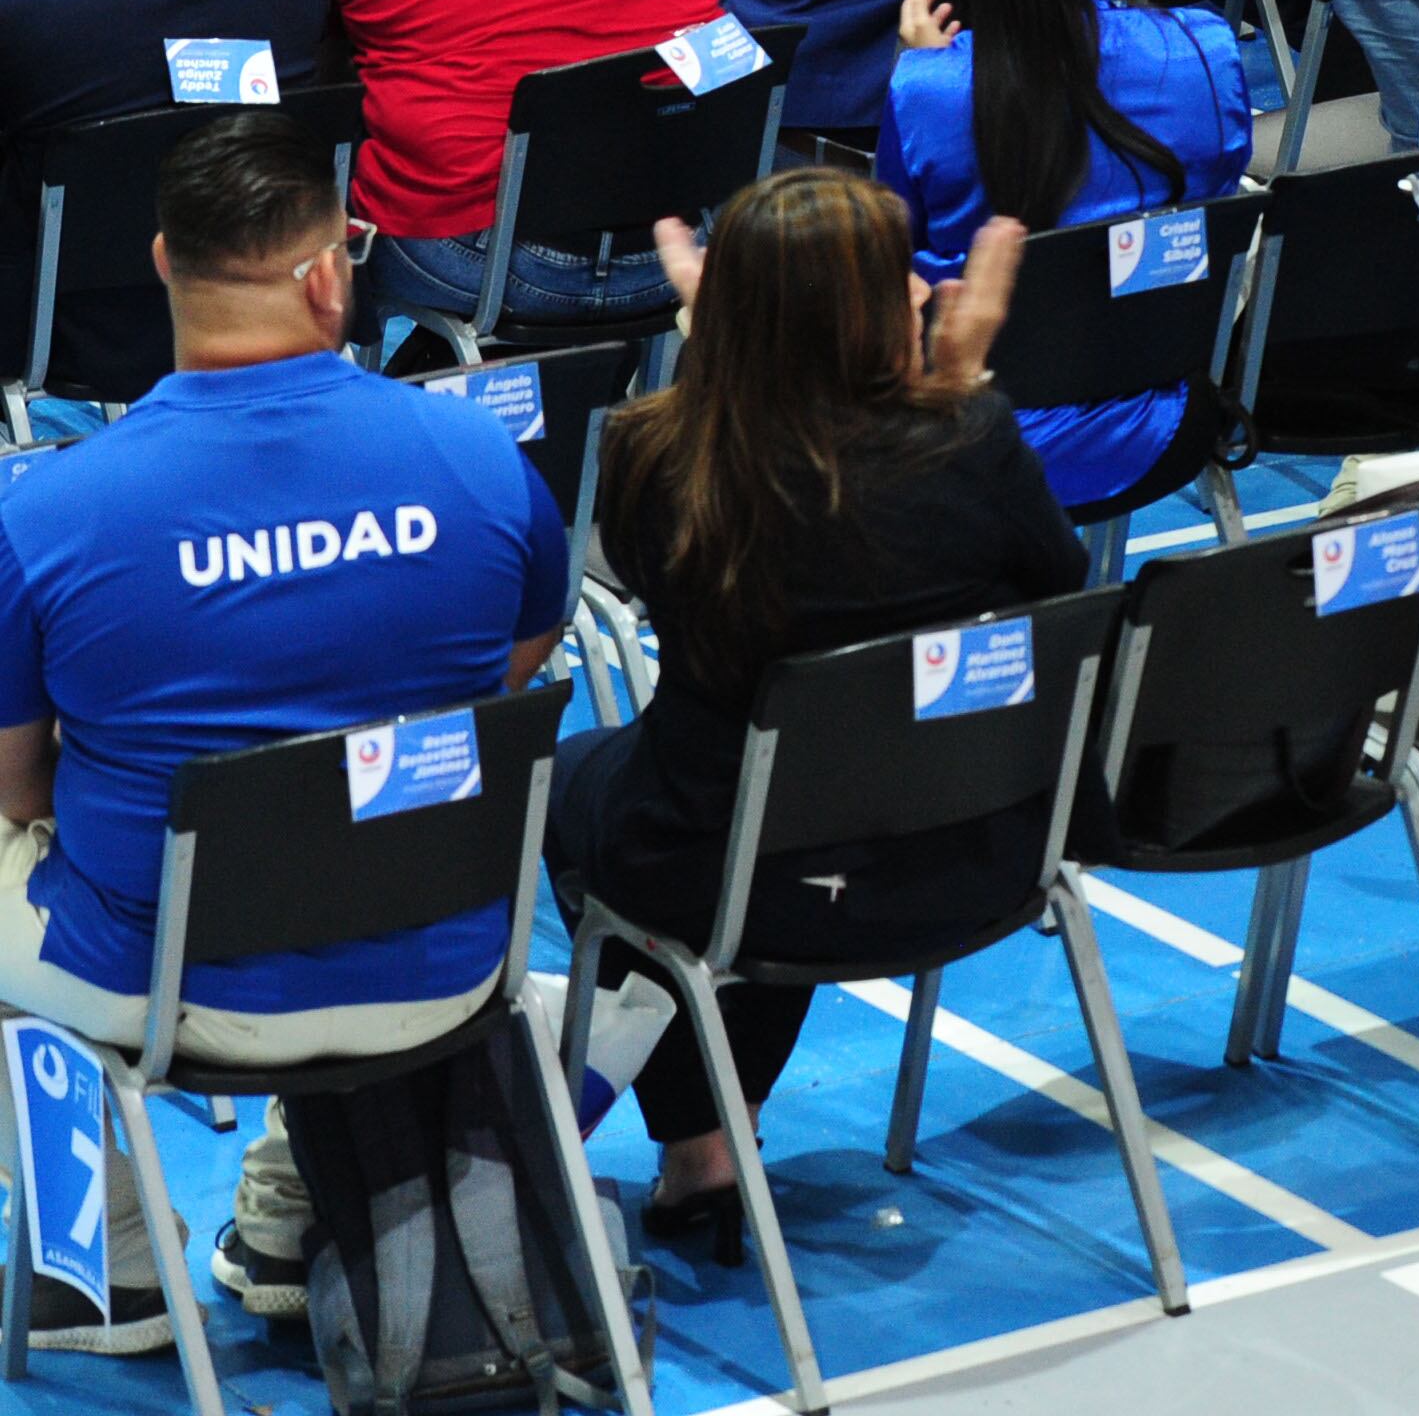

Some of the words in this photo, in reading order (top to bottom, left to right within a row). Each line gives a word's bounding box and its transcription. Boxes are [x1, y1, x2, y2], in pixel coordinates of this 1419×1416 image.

[176, 59, 229, 70] Sánchez
[178, 69, 223, 81] Zúñiga
[180, 80, 219, 92] Teddy
[494, 401, 535, 416] rriero
[179, 505, 437, 587] UNIDAD
